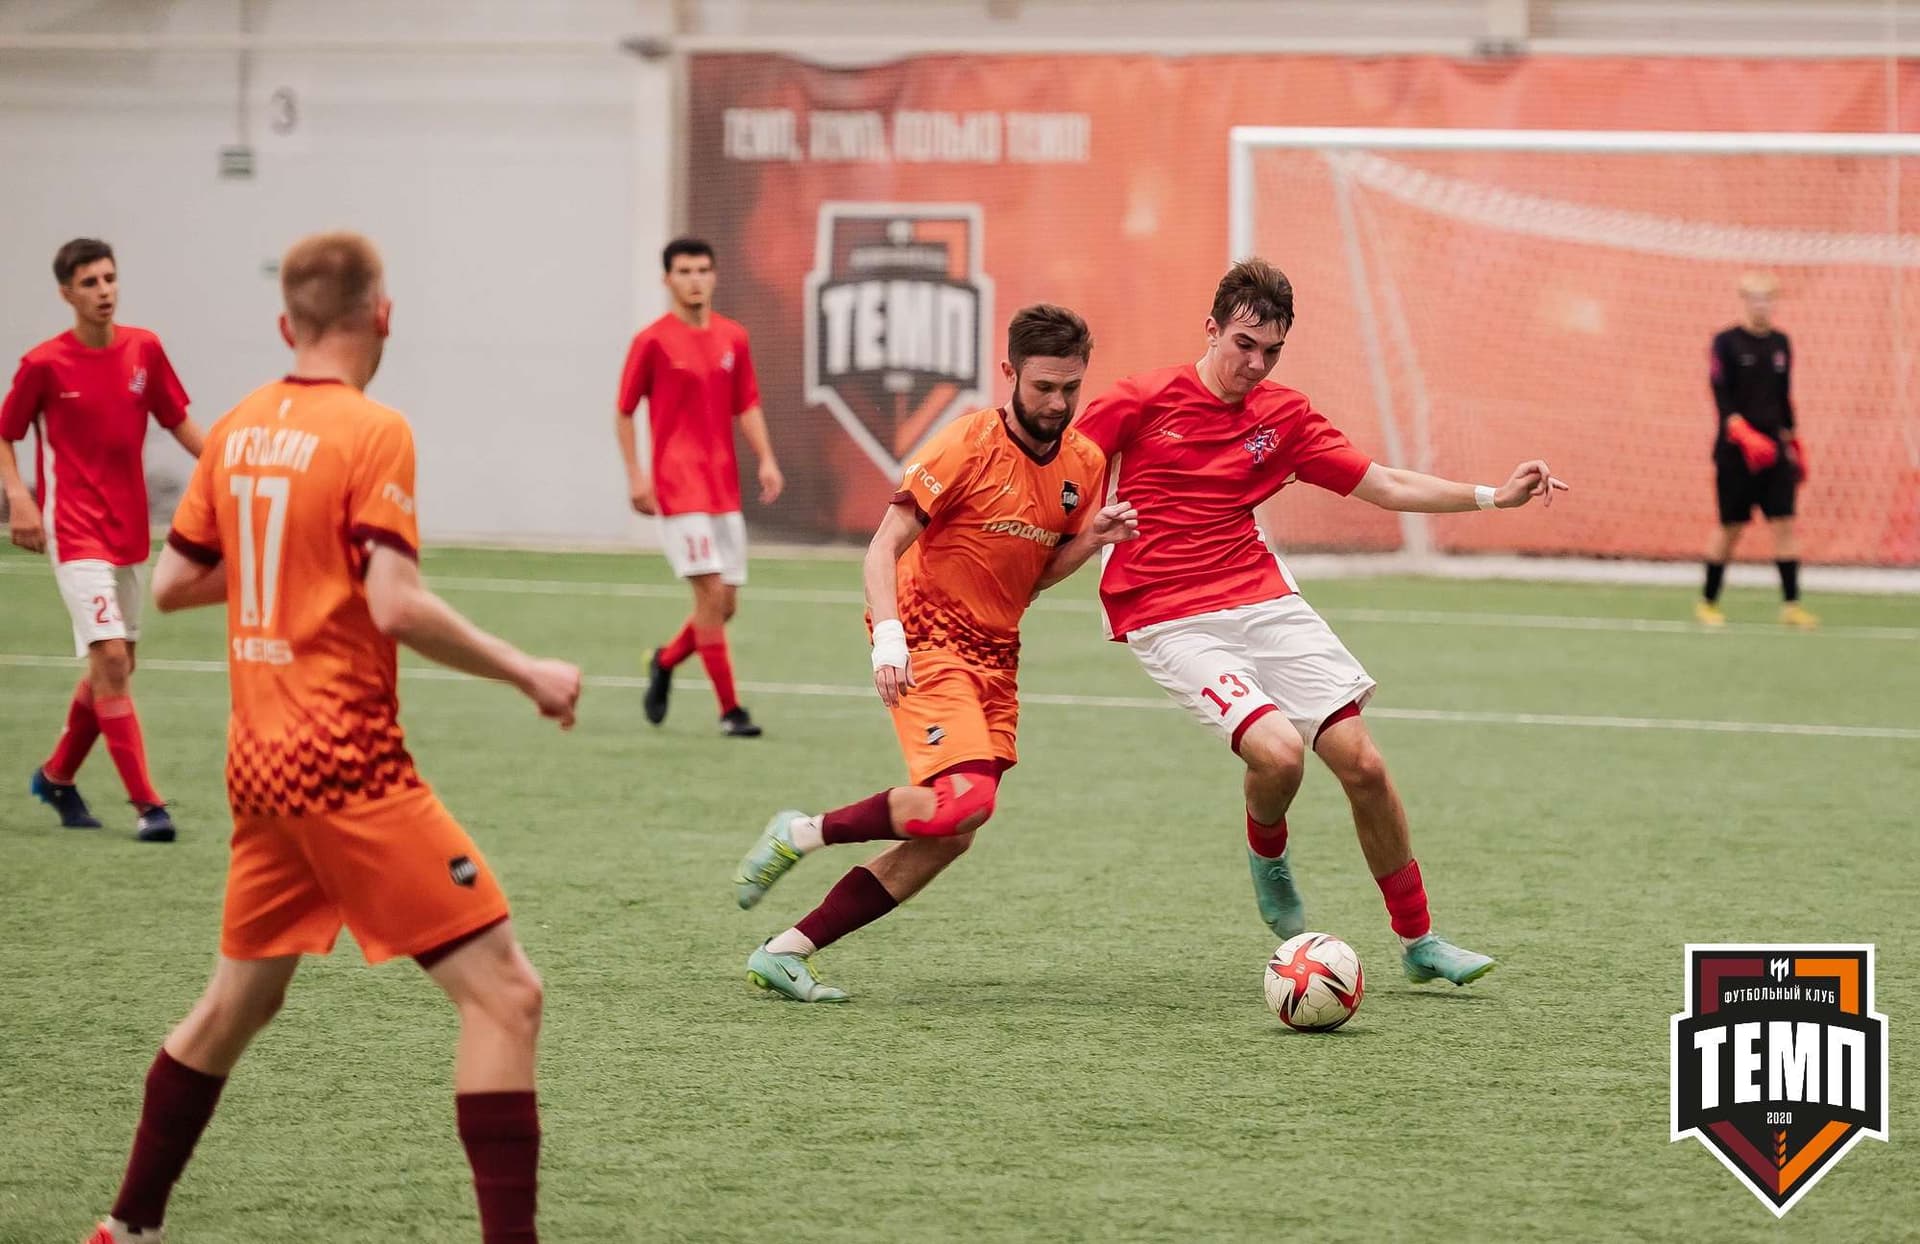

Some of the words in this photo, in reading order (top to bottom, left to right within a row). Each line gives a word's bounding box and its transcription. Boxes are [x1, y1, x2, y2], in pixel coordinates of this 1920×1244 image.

[271, 86, 299, 136] 3
[821, 280, 976, 379] ТЕМП
[230, 474, 290, 630] 17
[1201, 673, 1250, 717] 13
